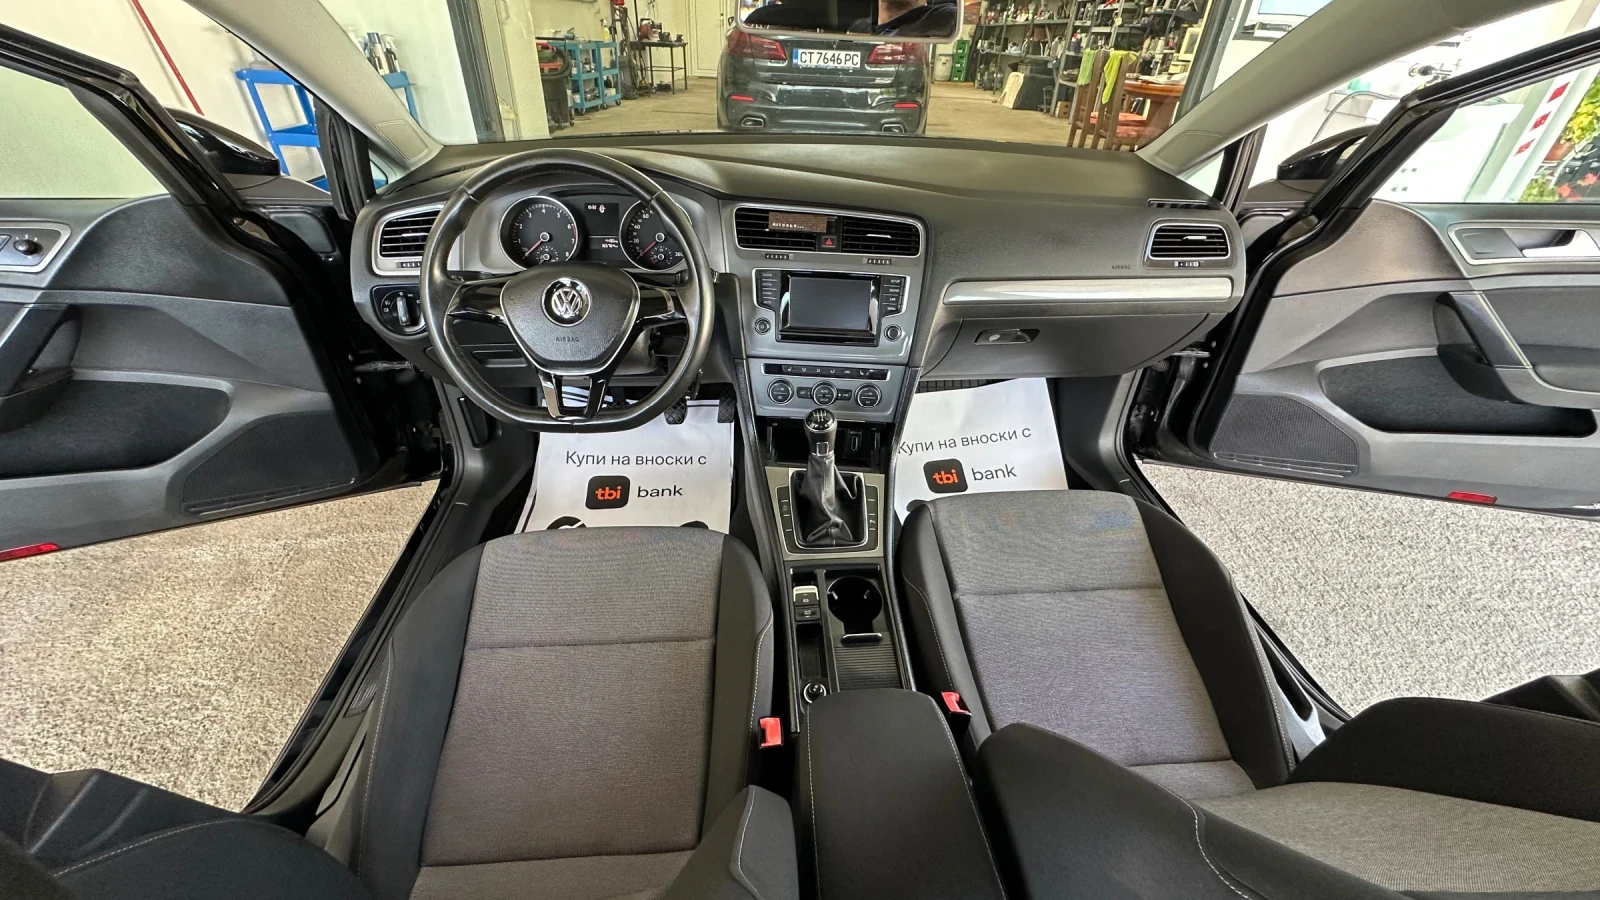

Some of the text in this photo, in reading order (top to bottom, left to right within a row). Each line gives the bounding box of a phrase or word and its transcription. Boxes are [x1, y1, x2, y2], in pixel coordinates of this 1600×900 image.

[800, 52, 859, 66] CT 7646 PC
[898, 427, 1032, 456] Купи на вноски с
[565, 450, 707, 468] Купи на вноски с
[933, 464, 1017, 484] tbi bank
[595, 485, 683, 500] tbi bank
